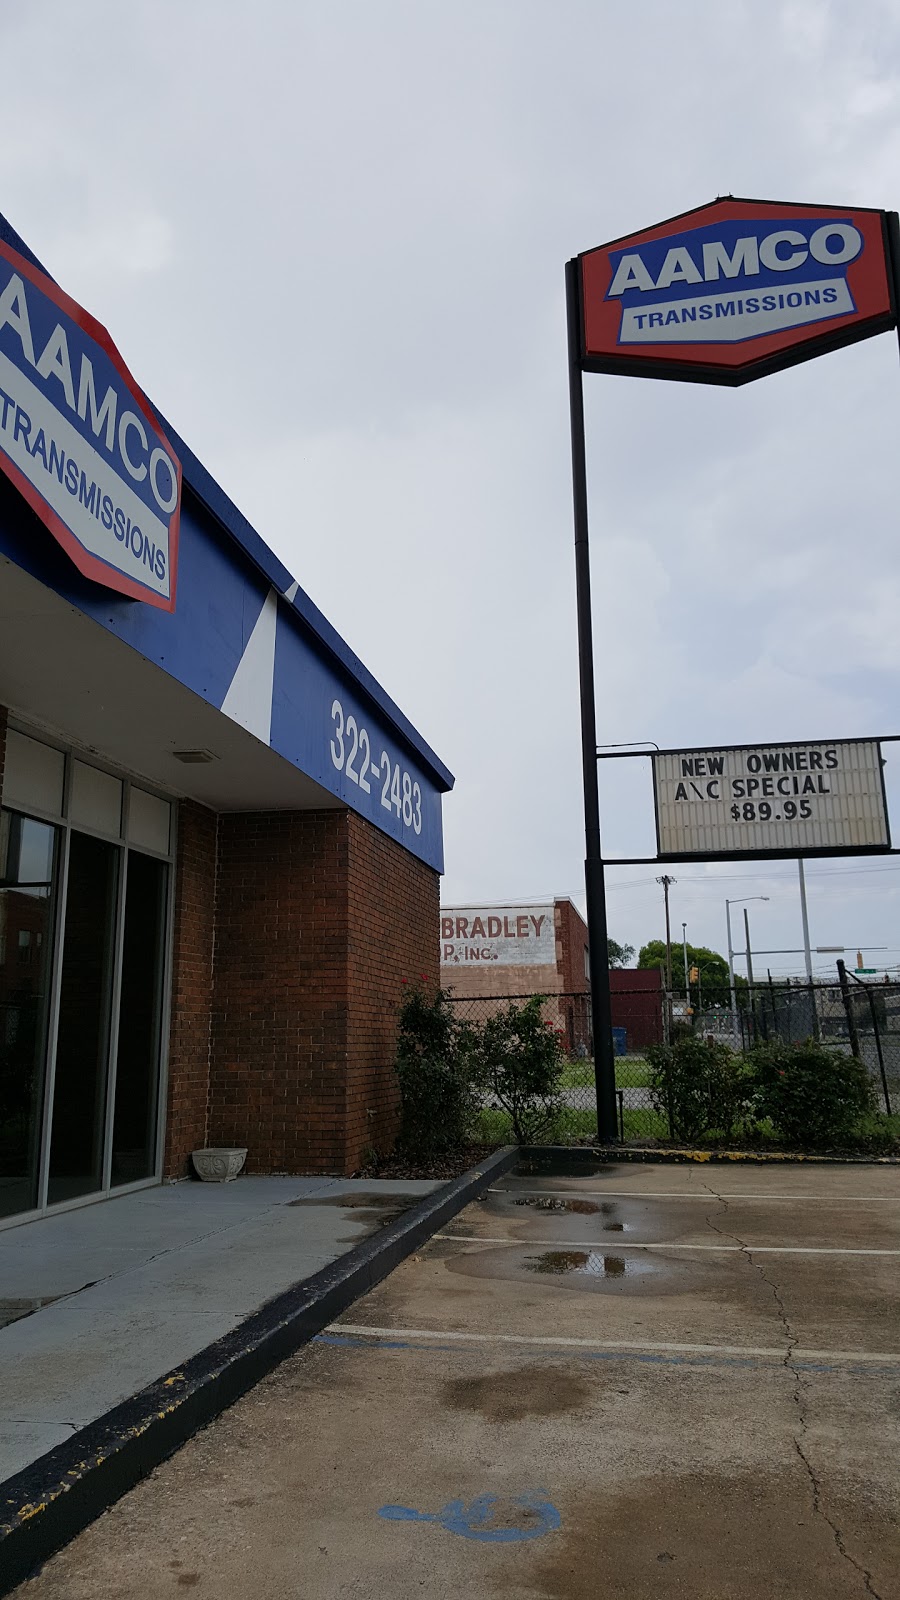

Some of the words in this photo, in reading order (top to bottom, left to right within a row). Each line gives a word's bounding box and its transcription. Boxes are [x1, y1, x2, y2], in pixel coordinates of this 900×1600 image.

[608, 223, 862, 296] AAMCO
[633, 288, 838, 329] TRANSMISSIONS
[0, 273, 178, 514] AAMCO
[0, 387, 166, 580] TRANSMISSIONS
[330, 700, 422, 835] 322-2483
[681, 757, 724, 777] NEW
[747, 750, 838, 773] OWNERS
[675, 780, 719, 800] A\C
[732, 775, 830, 797] SPECIAL
[730, 800, 812, 821] $89.95
[441, 915, 545, 939] BRADLEY
